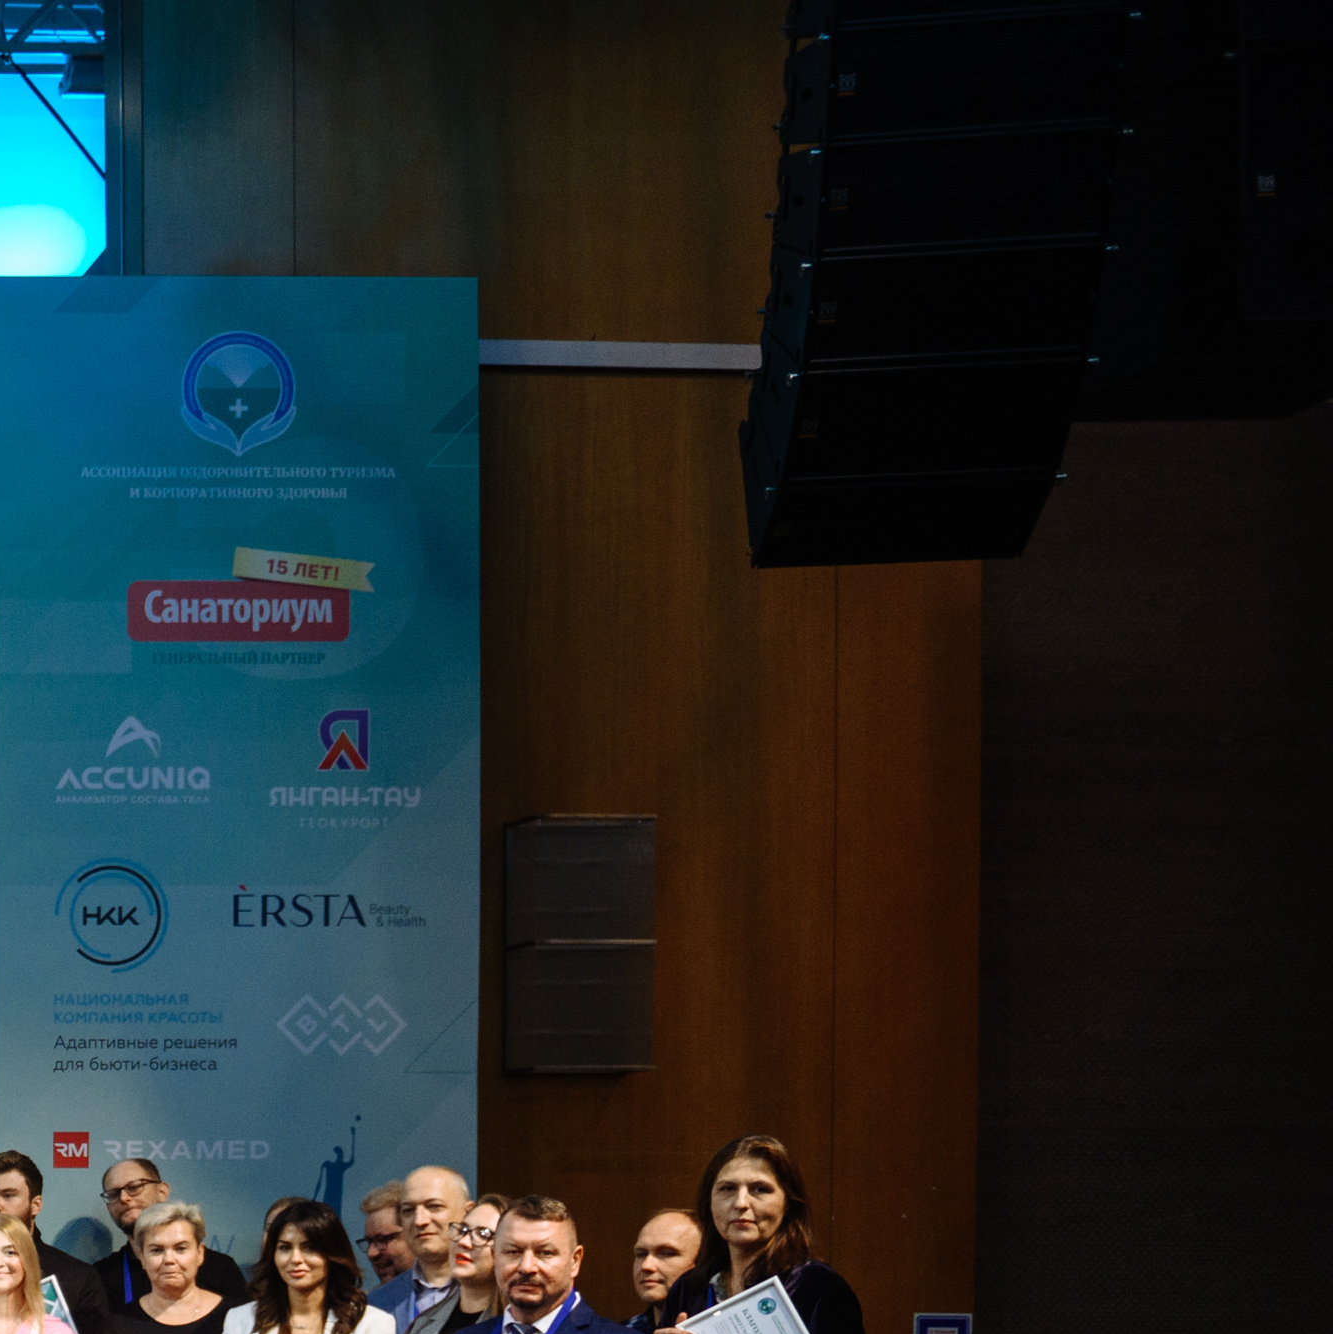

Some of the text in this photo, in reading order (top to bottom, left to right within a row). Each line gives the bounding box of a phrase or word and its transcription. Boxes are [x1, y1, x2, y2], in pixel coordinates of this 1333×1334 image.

[80, 467, 396, 480] АССОЦИАЦИЯ ОЗДОРОВИТЕЛЬНОГО ТУРИЗМА
[129, 487, 348, 501] И КОРПОРАТИВНОГО ЗДОРОВЬЯ
[266, 558, 340, 581] 15 ЛЕТ!
[144, 589, 333, 632] Санаториум
[152, 650, 326, 665] ГЕНЕРАЛЬНЫЙ ПАРТНЕР
[55, 766, 211, 790] ACCUNIQ
[269, 786, 422, 809] ЯНГАН-ТАУ
[232, 884, 367, 928] ÈRSTA
[369, 903, 411, 917] Beauty
[376, 915, 426, 928] & Health
[53, 994, 190, 1008] НАЦИОНАЛЬНАЯ
[53, 1011, 223, 1024] КОМПАНИЯ КРАСОТЫ
[53, 1036, 238, 1052] Адаптивные решения
[53, 1056, 218, 1073] для бьюти-бизнеса
[103, 1139, 271, 1160] REXAMED
